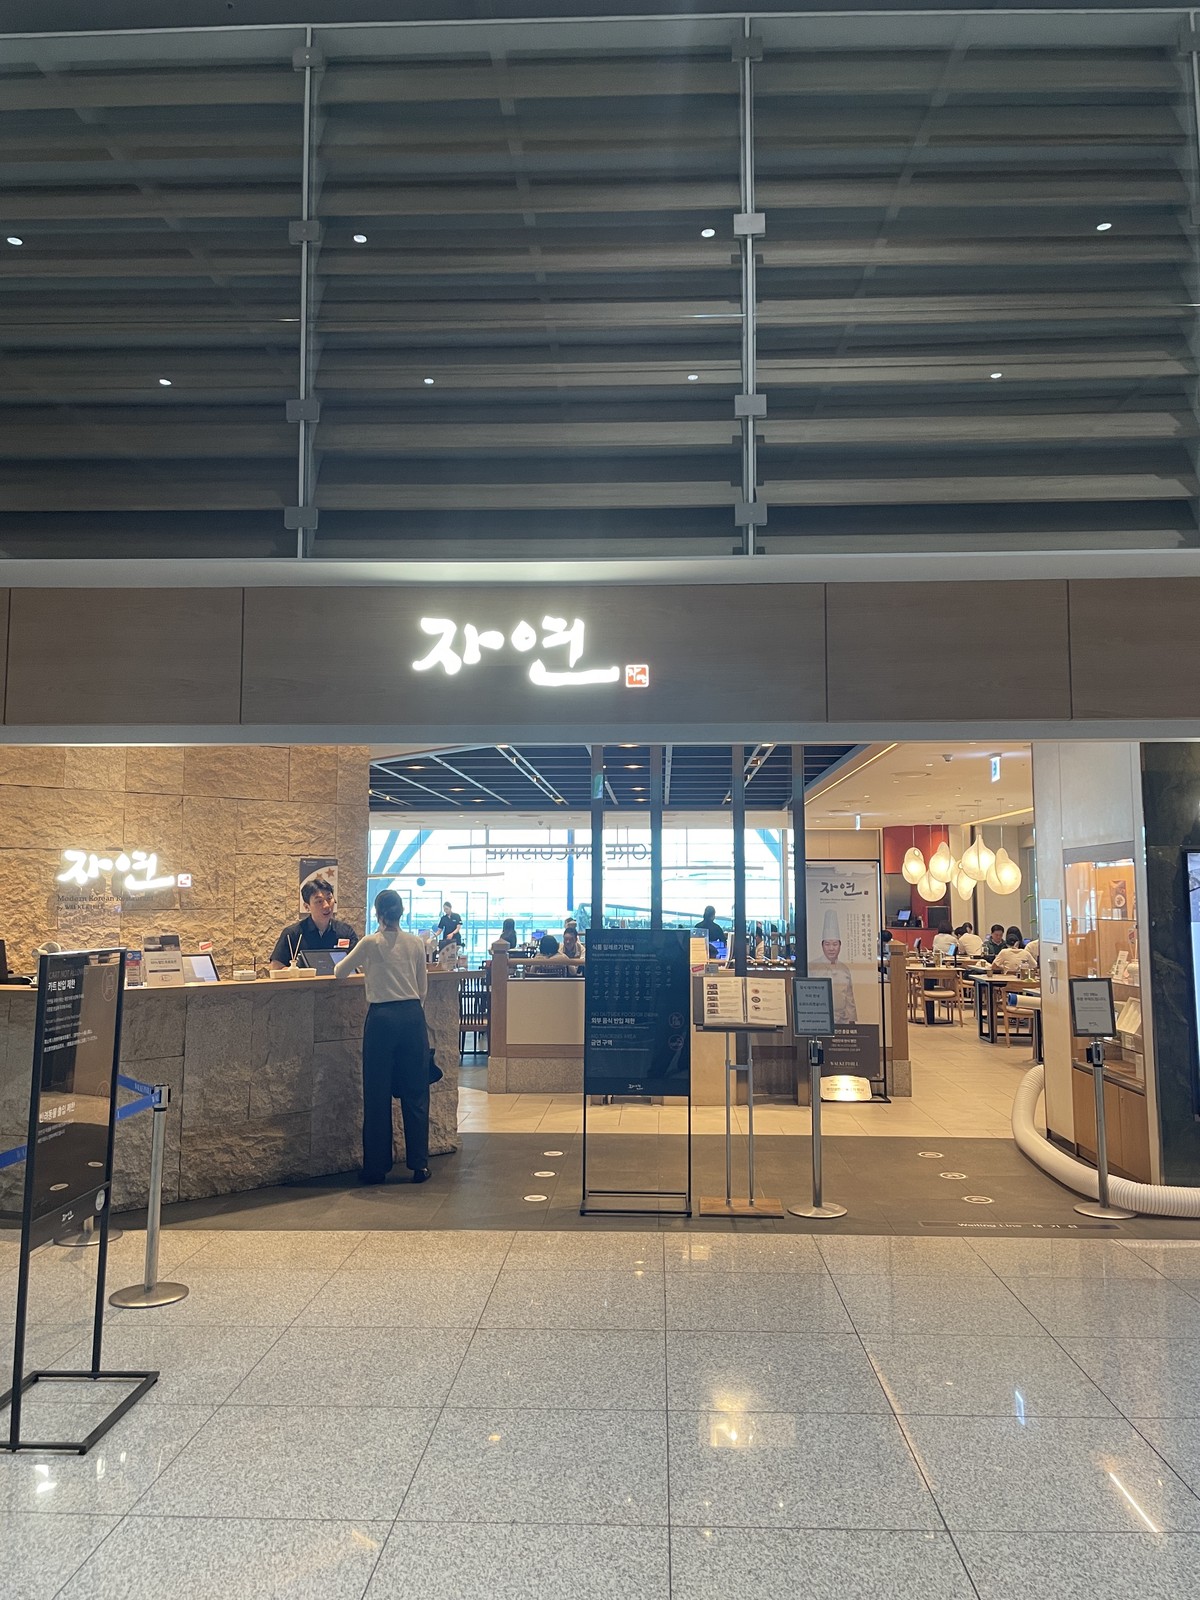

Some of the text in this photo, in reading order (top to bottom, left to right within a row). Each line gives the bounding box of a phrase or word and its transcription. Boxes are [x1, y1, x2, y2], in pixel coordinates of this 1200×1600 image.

[412, 615, 620, 686] 자연
[57, 850, 175, 890] 자연
[820, 882, 862, 896] 자연
[57, 894, 87, 902] Modern
[88, 894, 114, 902] Korean
[48, 981, 57, 991] 카트
[57, 980, 67, 991] 반입
